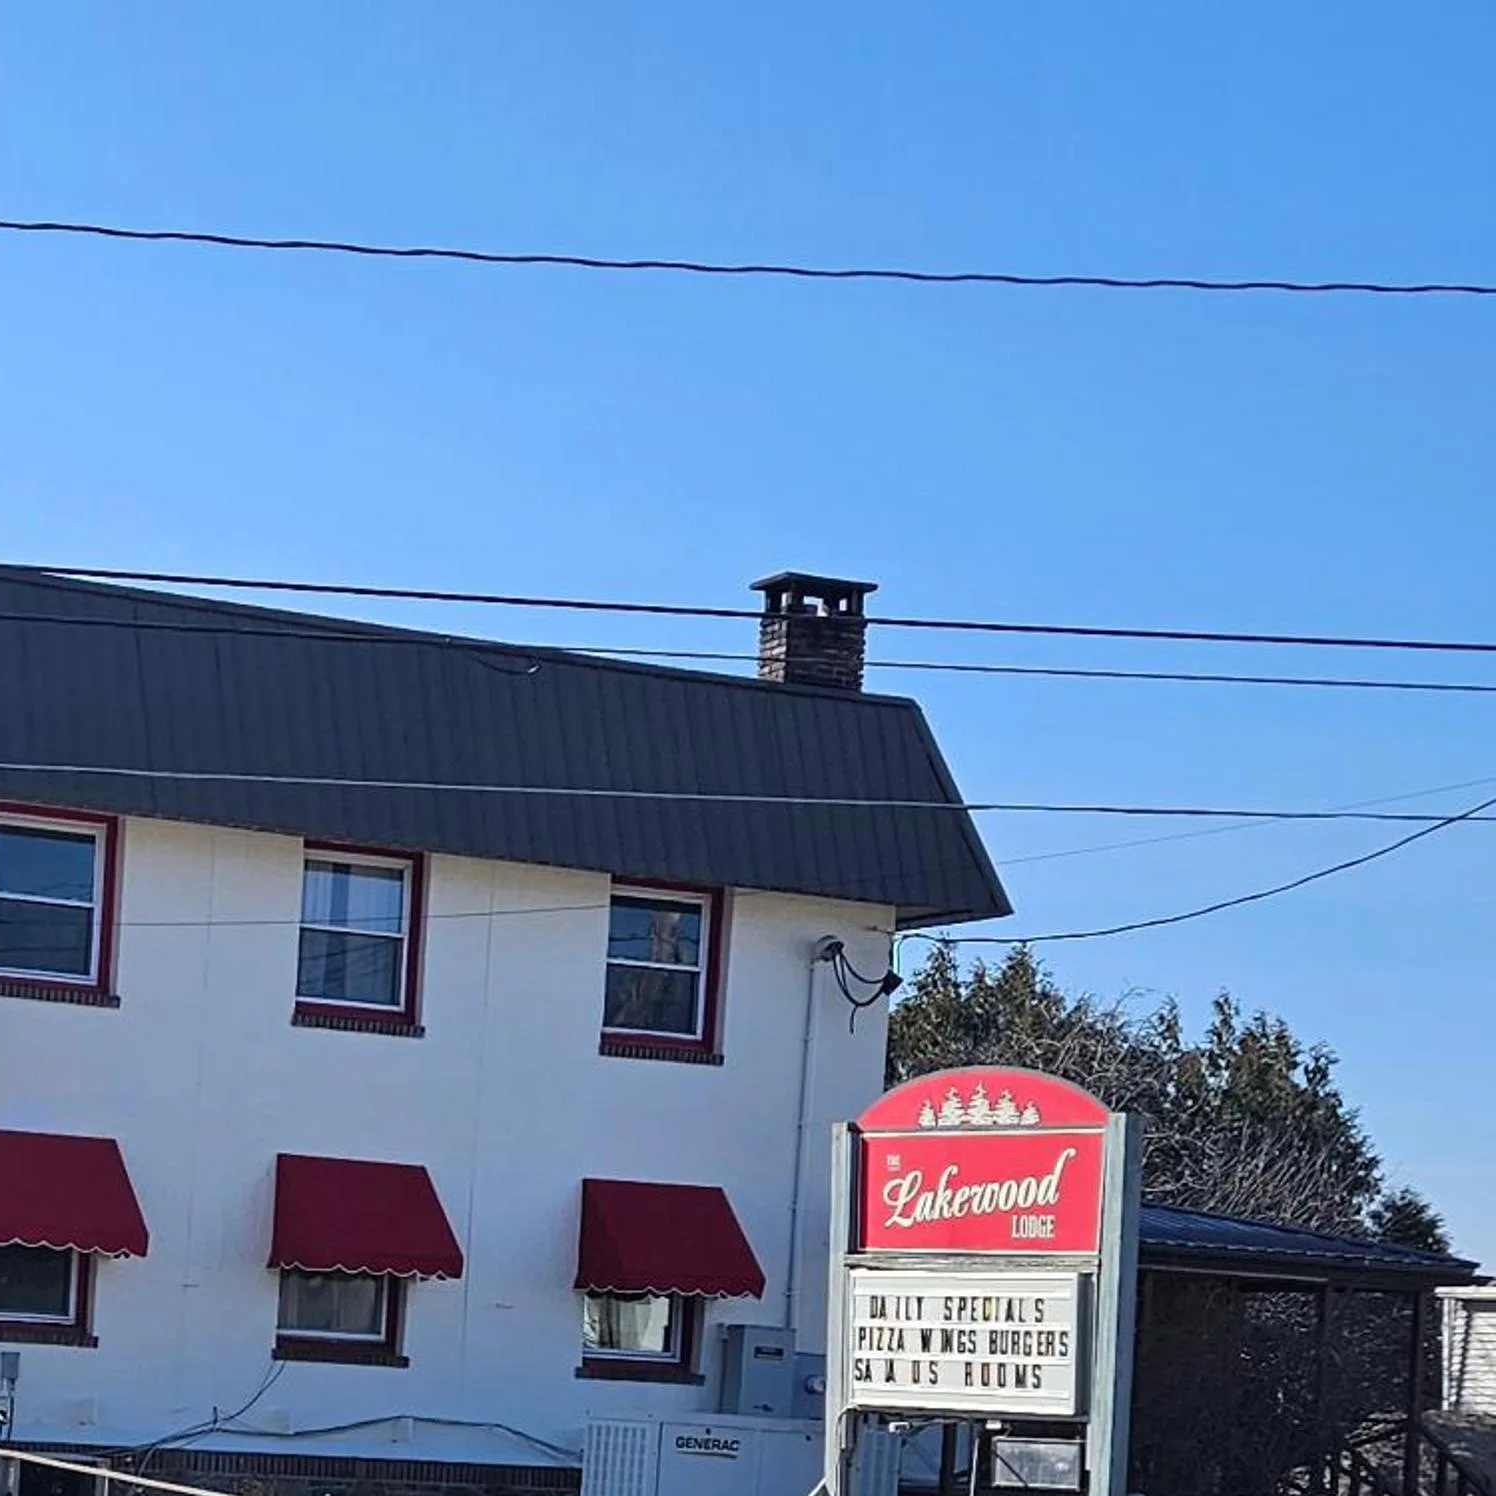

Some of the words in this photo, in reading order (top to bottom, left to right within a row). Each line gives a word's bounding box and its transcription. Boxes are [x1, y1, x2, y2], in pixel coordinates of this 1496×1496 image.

[882, 1147, 1076, 1228] Lakewood
[1011, 1215, 1056, 1238] LODGE
[869, 1295, 924, 1321] DAILY
[944, 1297, 1045, 1323] SPECIALS
[858, 1327, 905, 1352] PIZZA
[920, 1328, 977, 1354] WINGS
[989, 1330, 1069, 1357] BURGERS
[964, 1362, 1042, 1389] ROOMS
[675, 1435, 741, 1451] GENERAC
